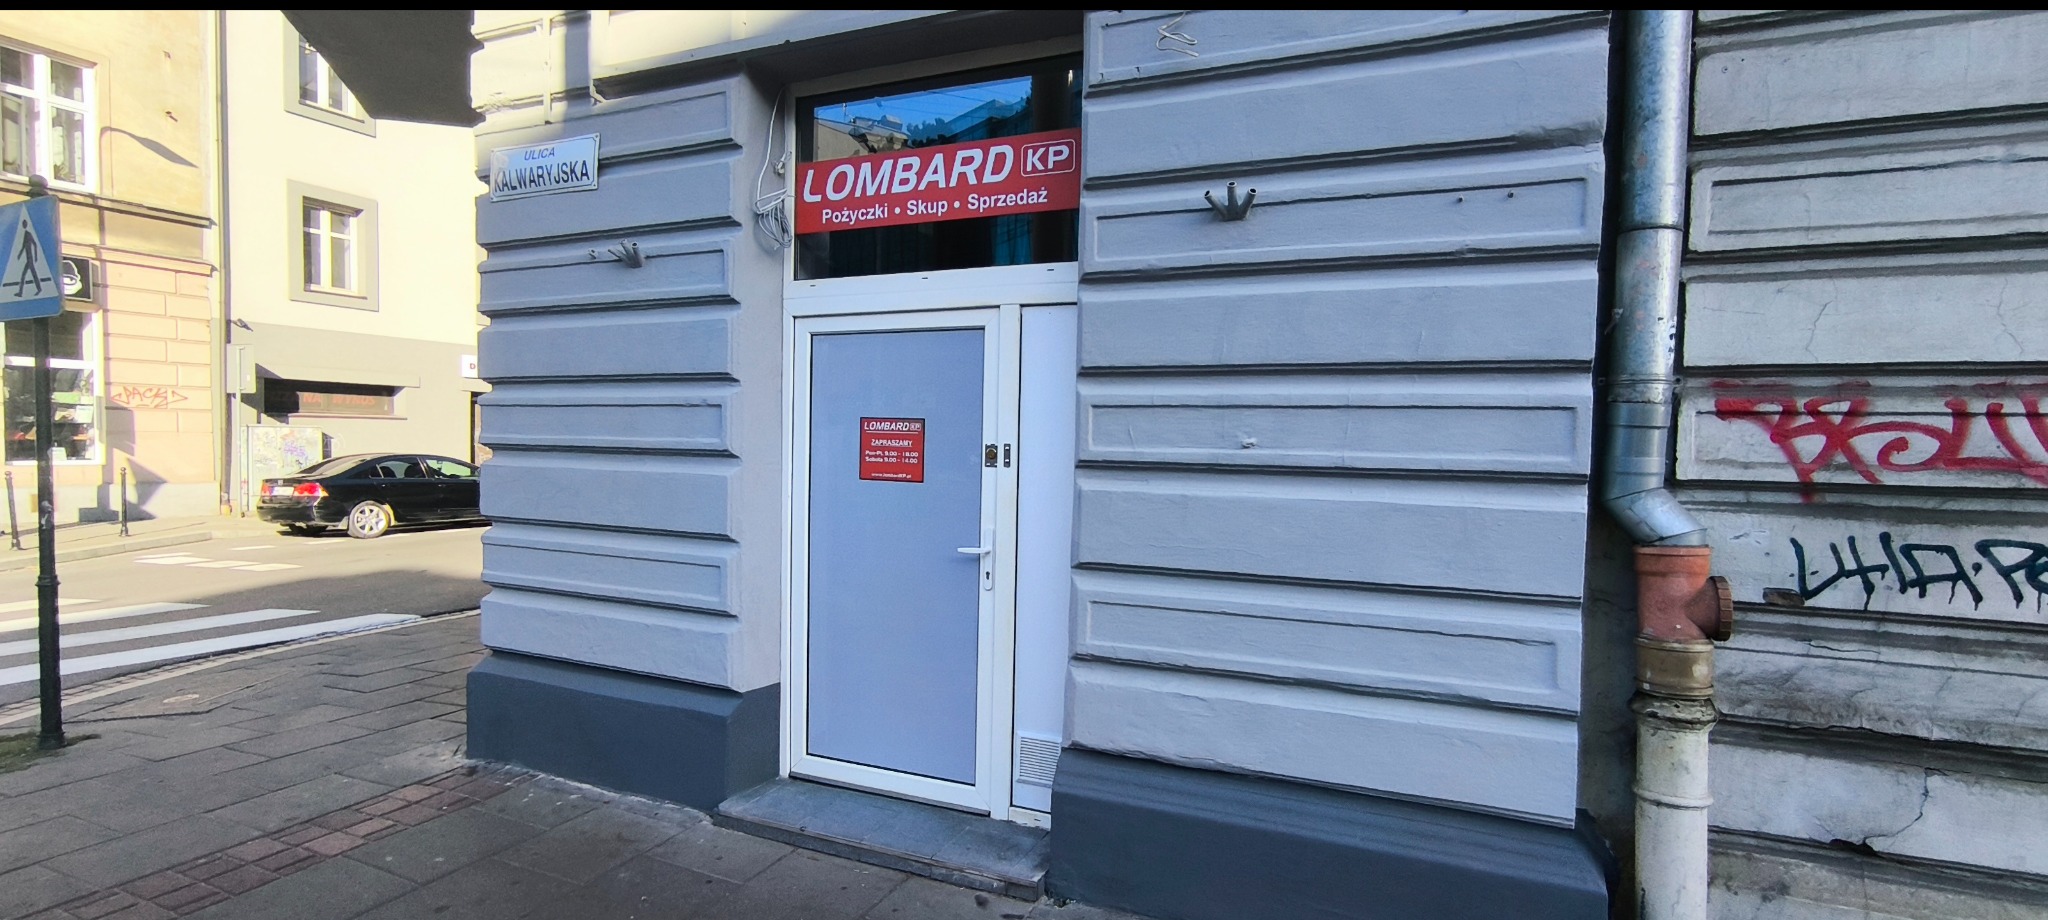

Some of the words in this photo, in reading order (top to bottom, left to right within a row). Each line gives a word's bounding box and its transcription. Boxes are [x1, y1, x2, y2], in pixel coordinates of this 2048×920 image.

[524, 147, 555, 161] ULICA
[494, 159, 590, 193] KALWARYJSKA
[803, 144, 1014, 203] LOMBARD
[1026, 144, 1070, 172] KP
[822, 203, 888, 225] Pożyczki
[907, 199, 948, 217] Skup
[967, 186, 1048, 213] Sprzedaż
[864, 421, 910, 431] LOMBARD
[871, 439, 912, 447] ZAPRASZAMY
